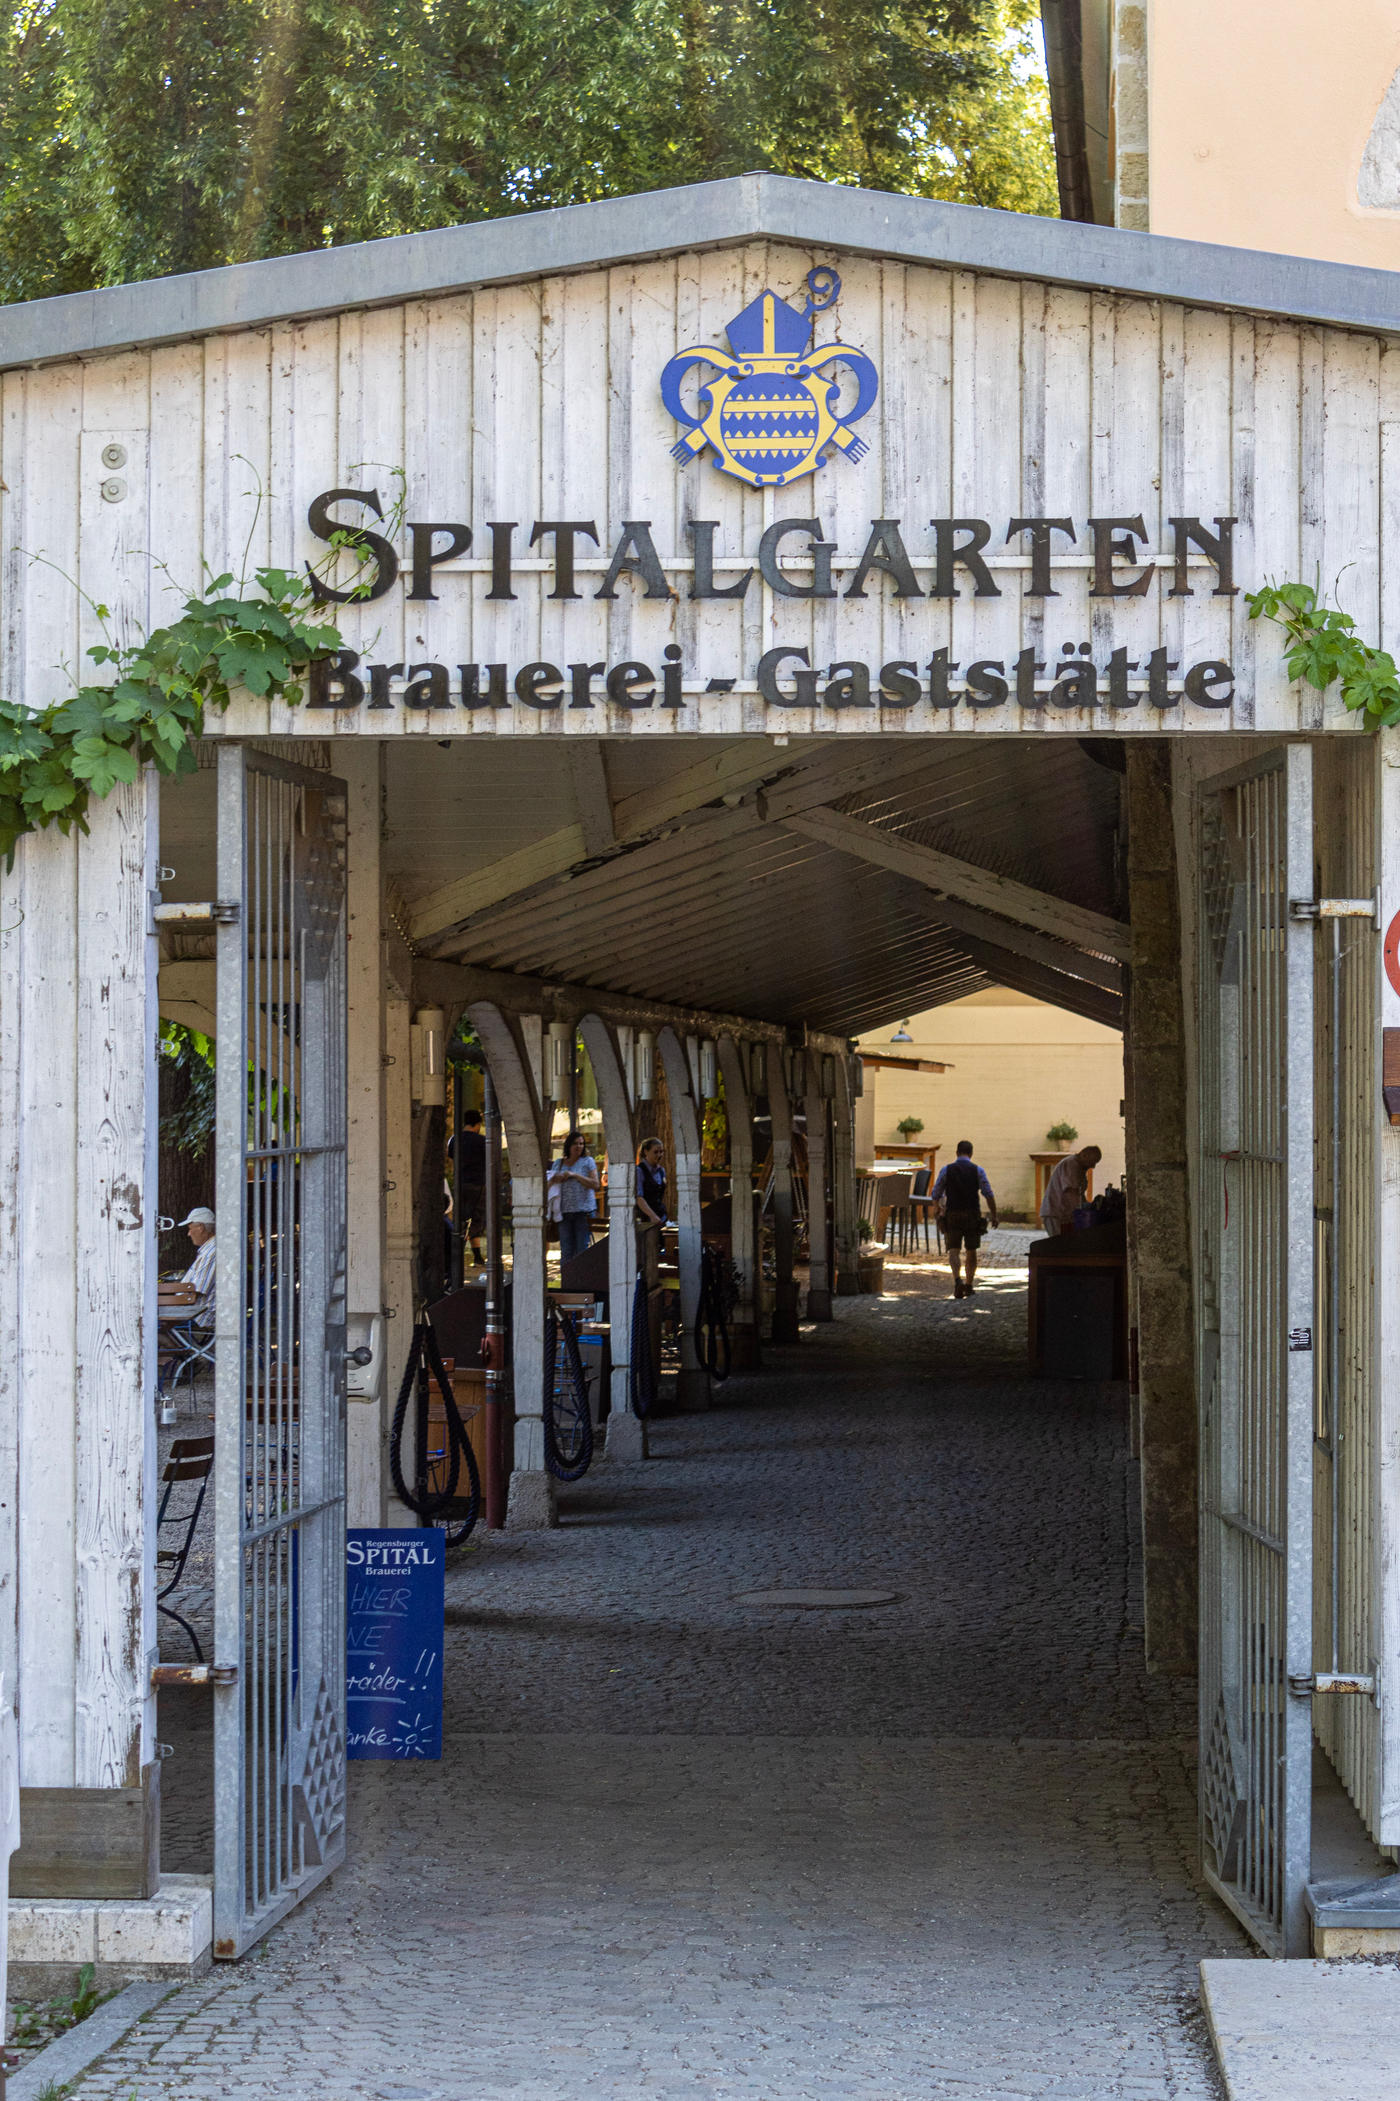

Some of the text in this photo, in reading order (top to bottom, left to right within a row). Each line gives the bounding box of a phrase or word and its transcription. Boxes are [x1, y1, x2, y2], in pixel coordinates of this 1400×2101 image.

[305, 488, 1239, 603] SPITALGARTEN
[346, 1541, 436, 1565] SPITAL
[366, 1540, 424, 1549] Regensburger
[365, 1566, 411, 1575] Brauerei
[351, 1583, 411, 1610] HIER
[347, 1726, 391, 1746] anke
